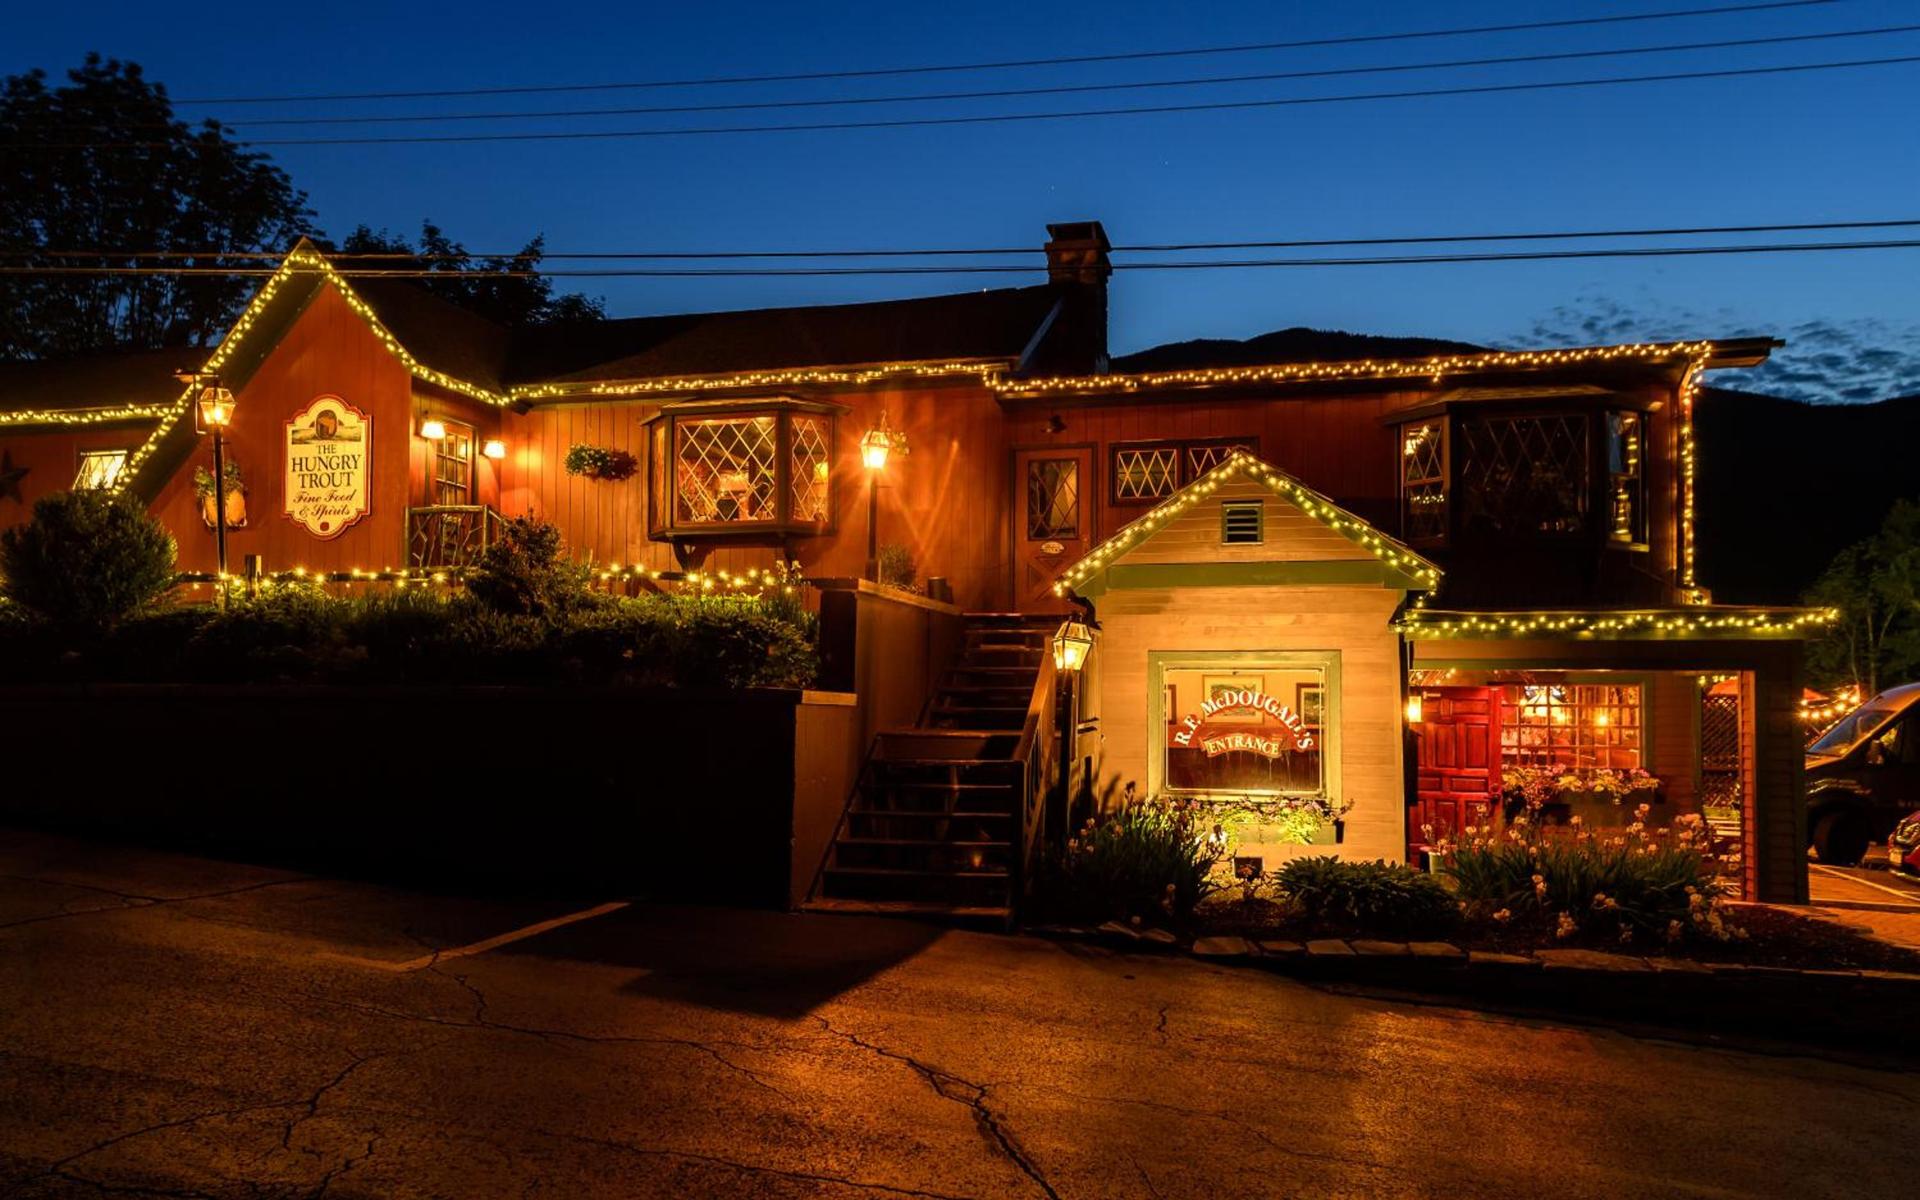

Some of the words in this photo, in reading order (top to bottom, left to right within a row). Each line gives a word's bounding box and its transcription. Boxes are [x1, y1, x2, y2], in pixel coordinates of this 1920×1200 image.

[316, 444, 337, 455] THE
[292, 454, 362, 472] HUNGRY
[298, 472, 354, 489] TROUT
[293, 491, 321, 503] Fine
[324, 489, 357, 502] Food
[299, 505, 309, 518] &
[311, 504, 350, 520] Spirits
[1208, 735, 1280, 755] ENTRANCE
